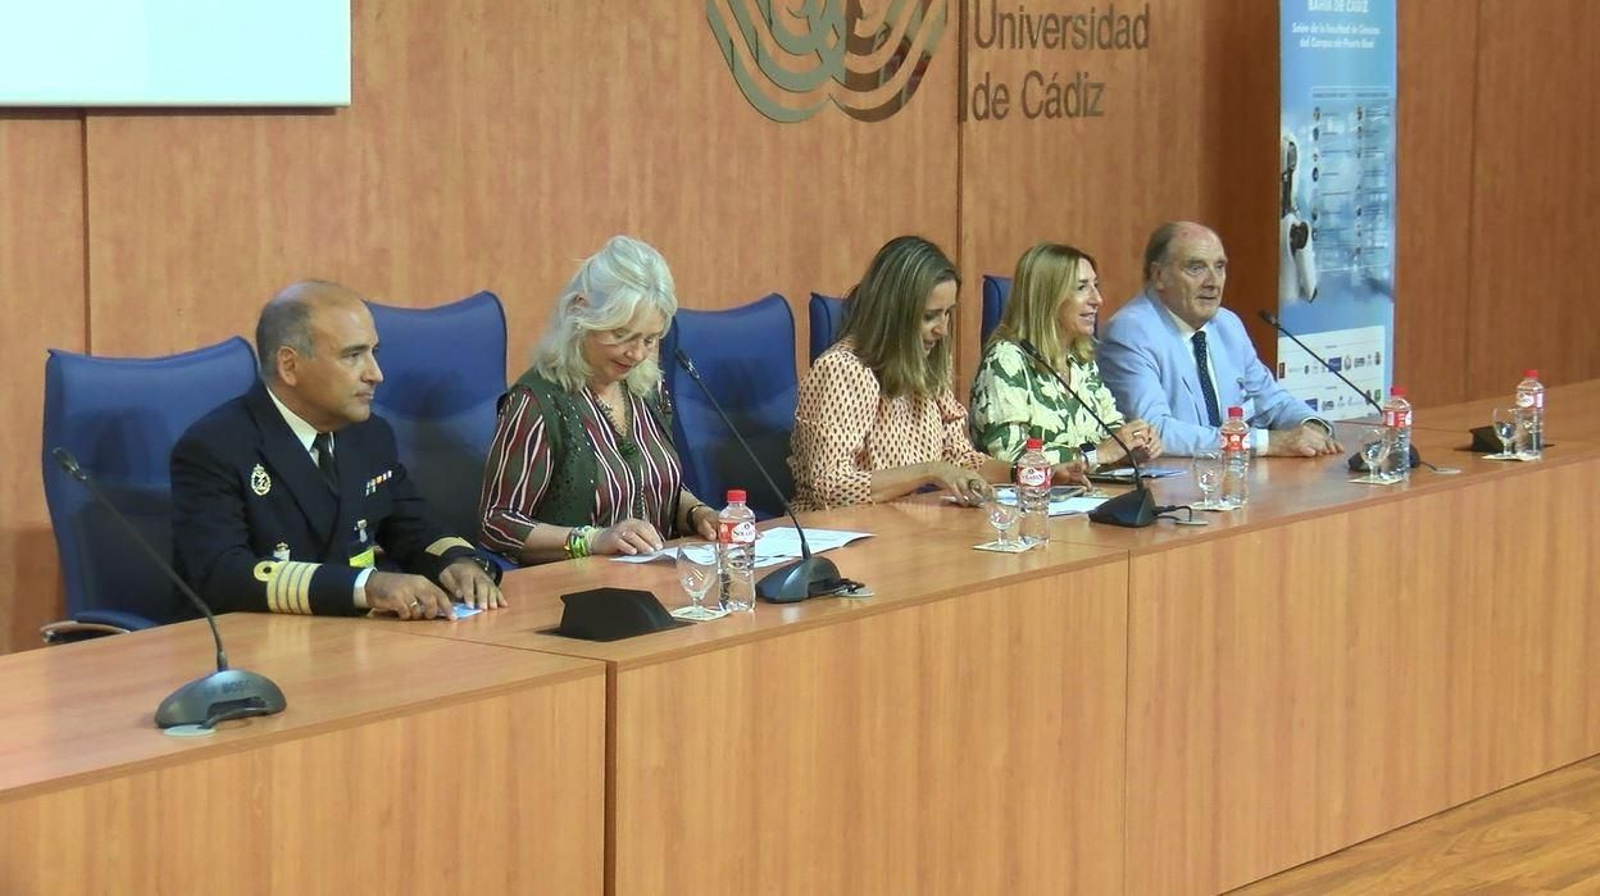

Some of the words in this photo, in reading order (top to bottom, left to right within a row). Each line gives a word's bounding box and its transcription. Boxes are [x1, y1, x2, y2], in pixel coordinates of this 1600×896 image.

[974, 0, 1150, 49] Universidad
[971, 71, 1010, 121] de
[1021, 70, 1105, 120] Cádiz
